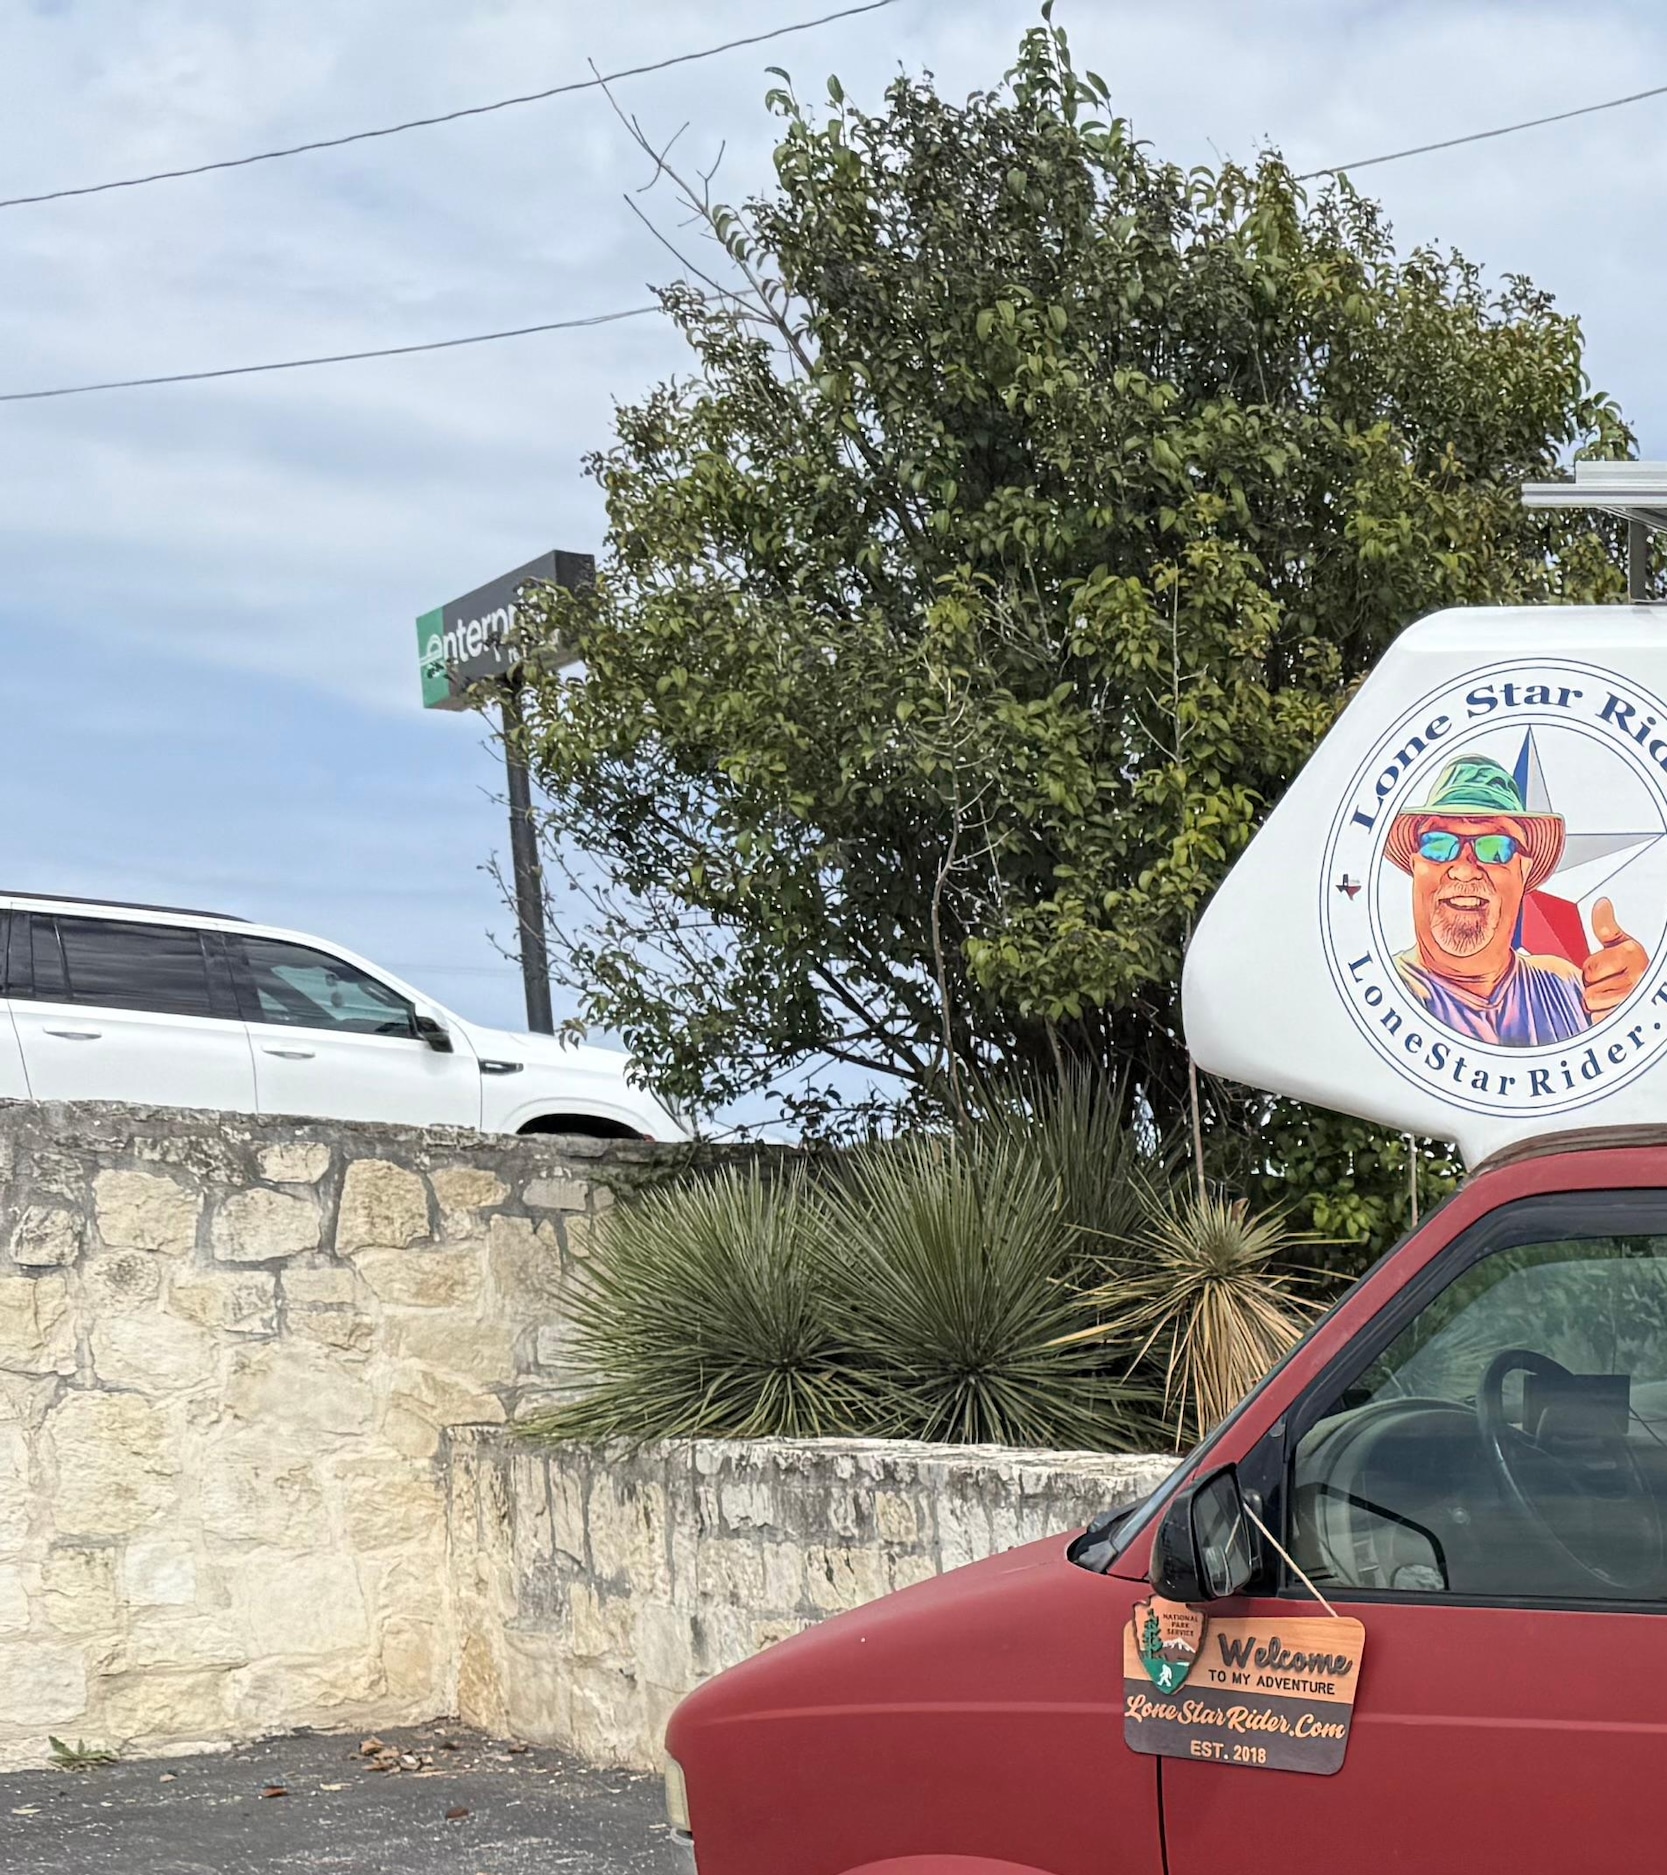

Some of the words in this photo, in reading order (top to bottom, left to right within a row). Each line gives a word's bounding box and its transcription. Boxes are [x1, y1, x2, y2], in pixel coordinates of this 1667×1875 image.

[1350, 714, 1453, 835] Lone
[1465, 682, 1583, 720] Star
[1163, 1613, 1199, 1622] NATIONAL
[1167, 1629, 1194, 1637] SERVICE
[1217, 1633, 1353, 1676] Welcome
[1208, 1669, 1226, 1682] TO
[1232, 1672, 1251, 1685] MY
[1256, 1676, 1336, 1695] ADVENTURE
[1190, 1740, 1229, 1760] EST.
[1233, 1745, 1267, 1764] 2018
